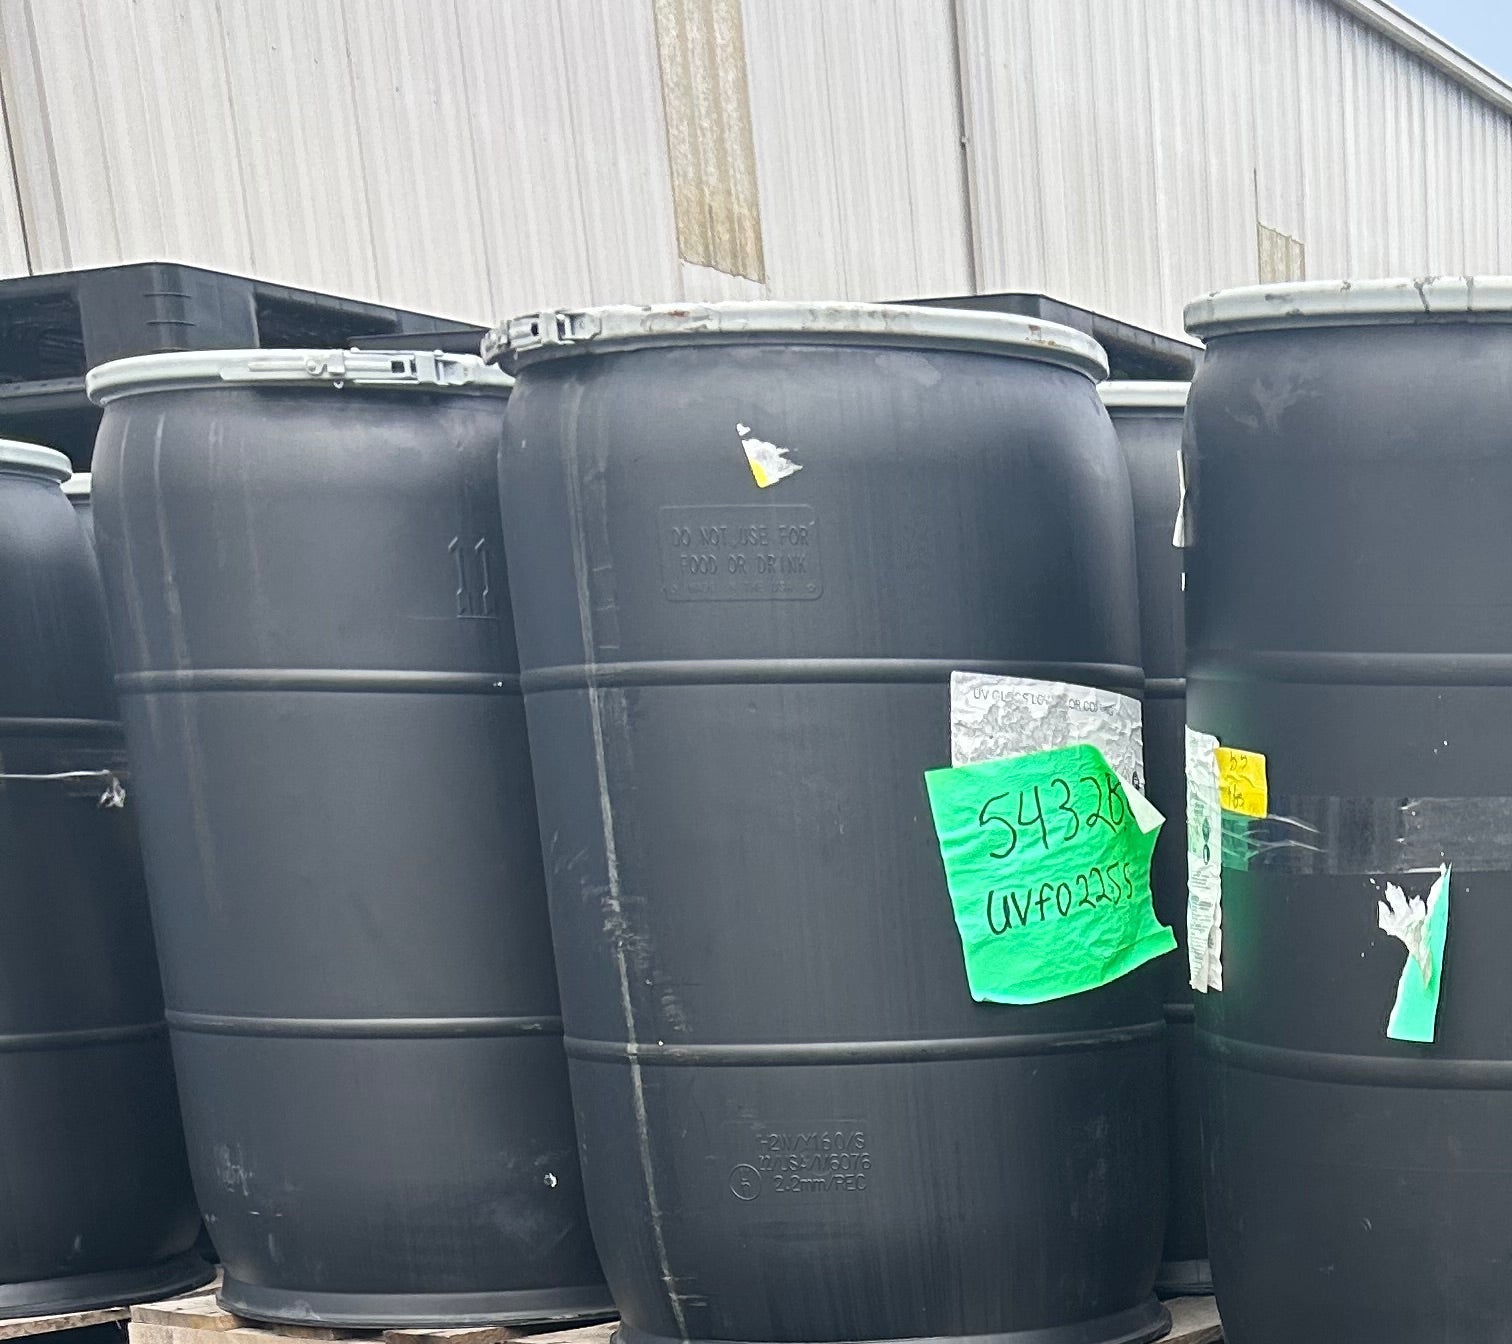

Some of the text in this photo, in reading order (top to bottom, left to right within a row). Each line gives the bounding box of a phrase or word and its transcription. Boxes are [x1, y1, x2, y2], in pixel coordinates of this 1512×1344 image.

[671, 524, 809, 547] DO NOT USE FOR
[680, 553, 807, 575] FOOD OR DRINK
